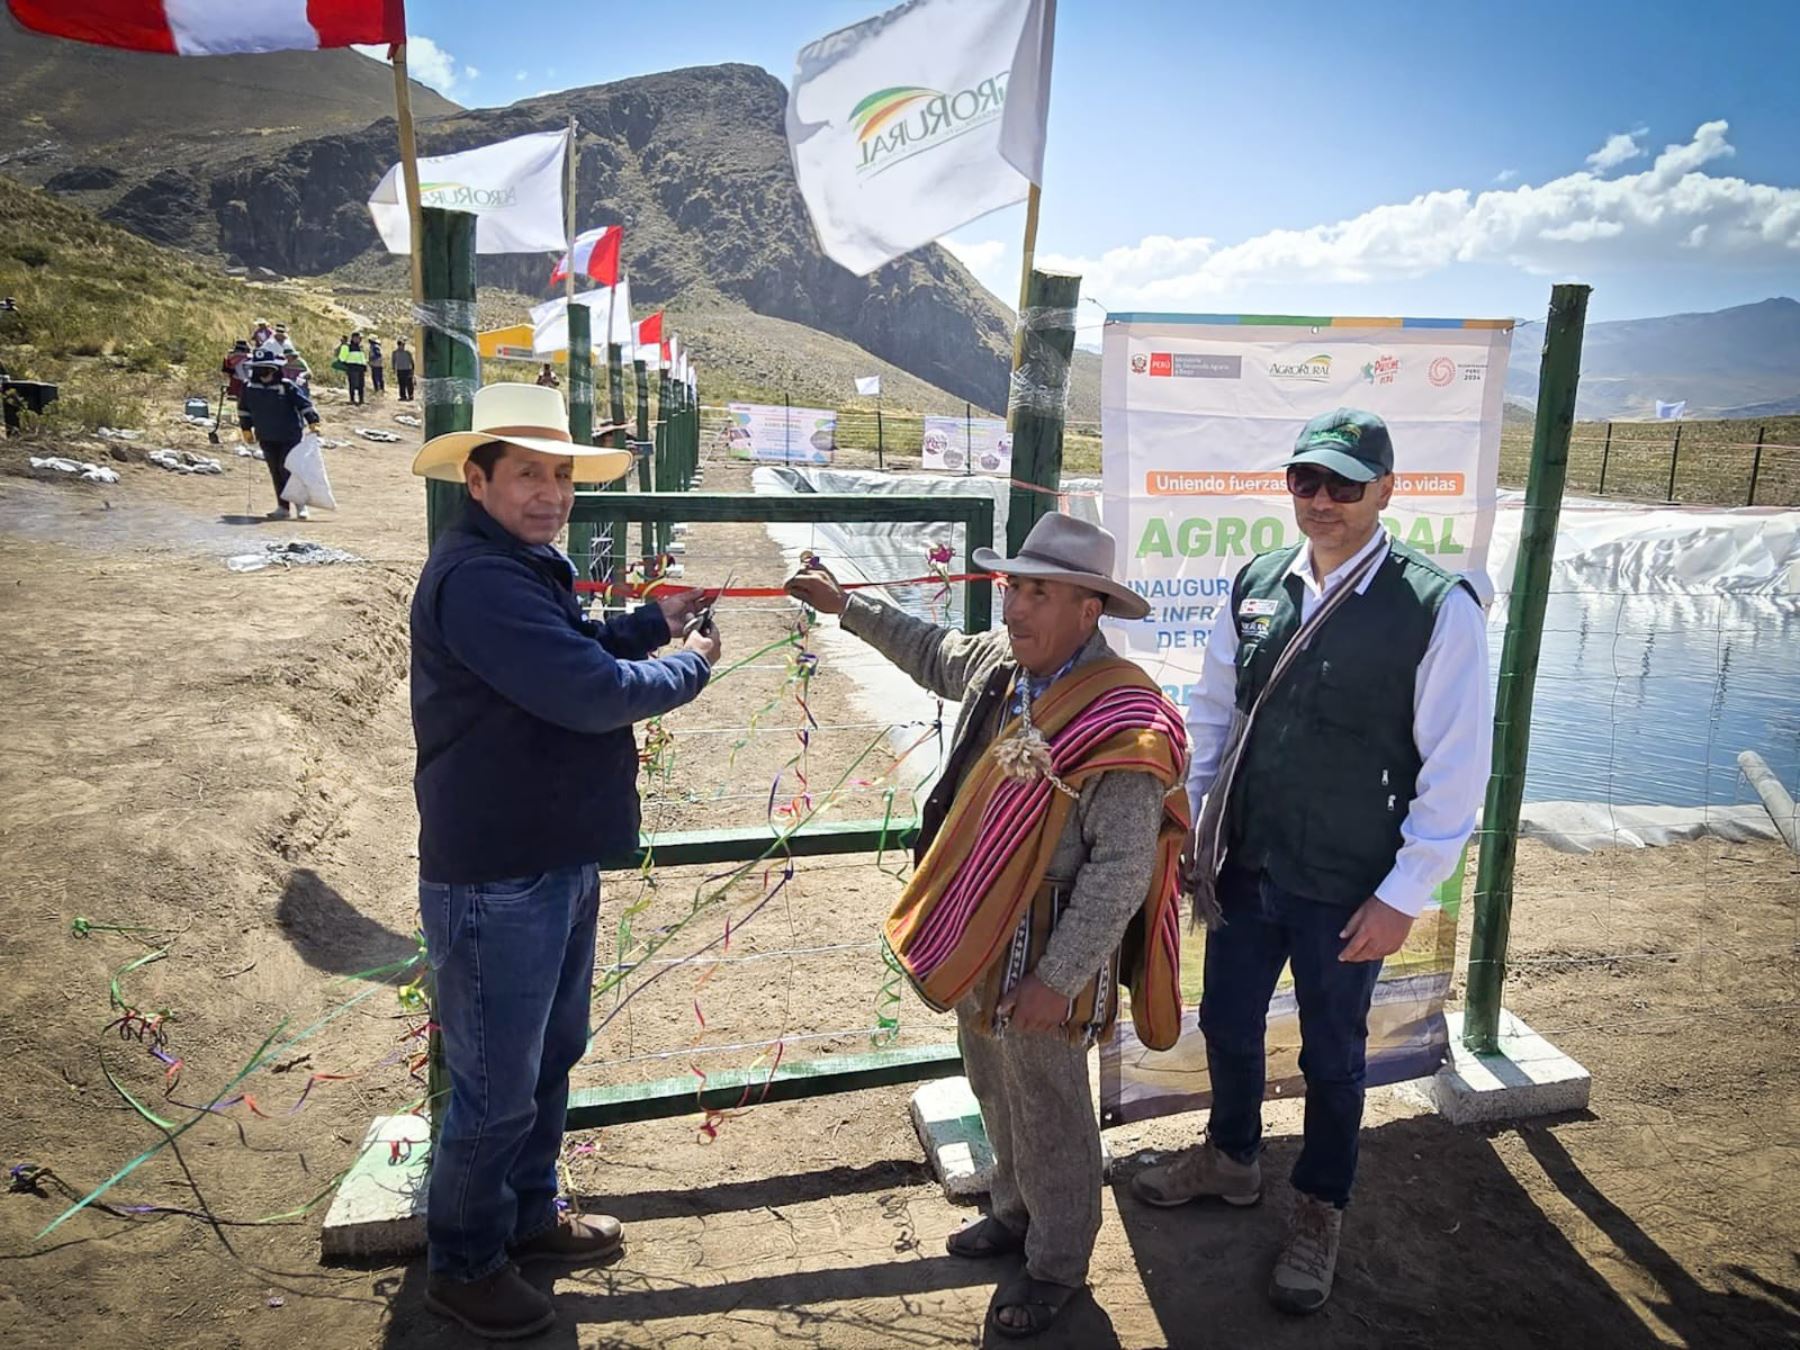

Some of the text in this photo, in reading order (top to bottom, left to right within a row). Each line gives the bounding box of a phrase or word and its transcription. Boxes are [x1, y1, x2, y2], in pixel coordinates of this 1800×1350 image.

[1156, 474, 1225, 492] Uniendo
[1228, 474, 1287, 491] fuerzas
[1414, 475, 1457, 491] vidas
[1135, 517, 1285, 558] AGRO
[1162, 605, 1217, 623] INFR
[1157, 630, 1187, 648] DE
